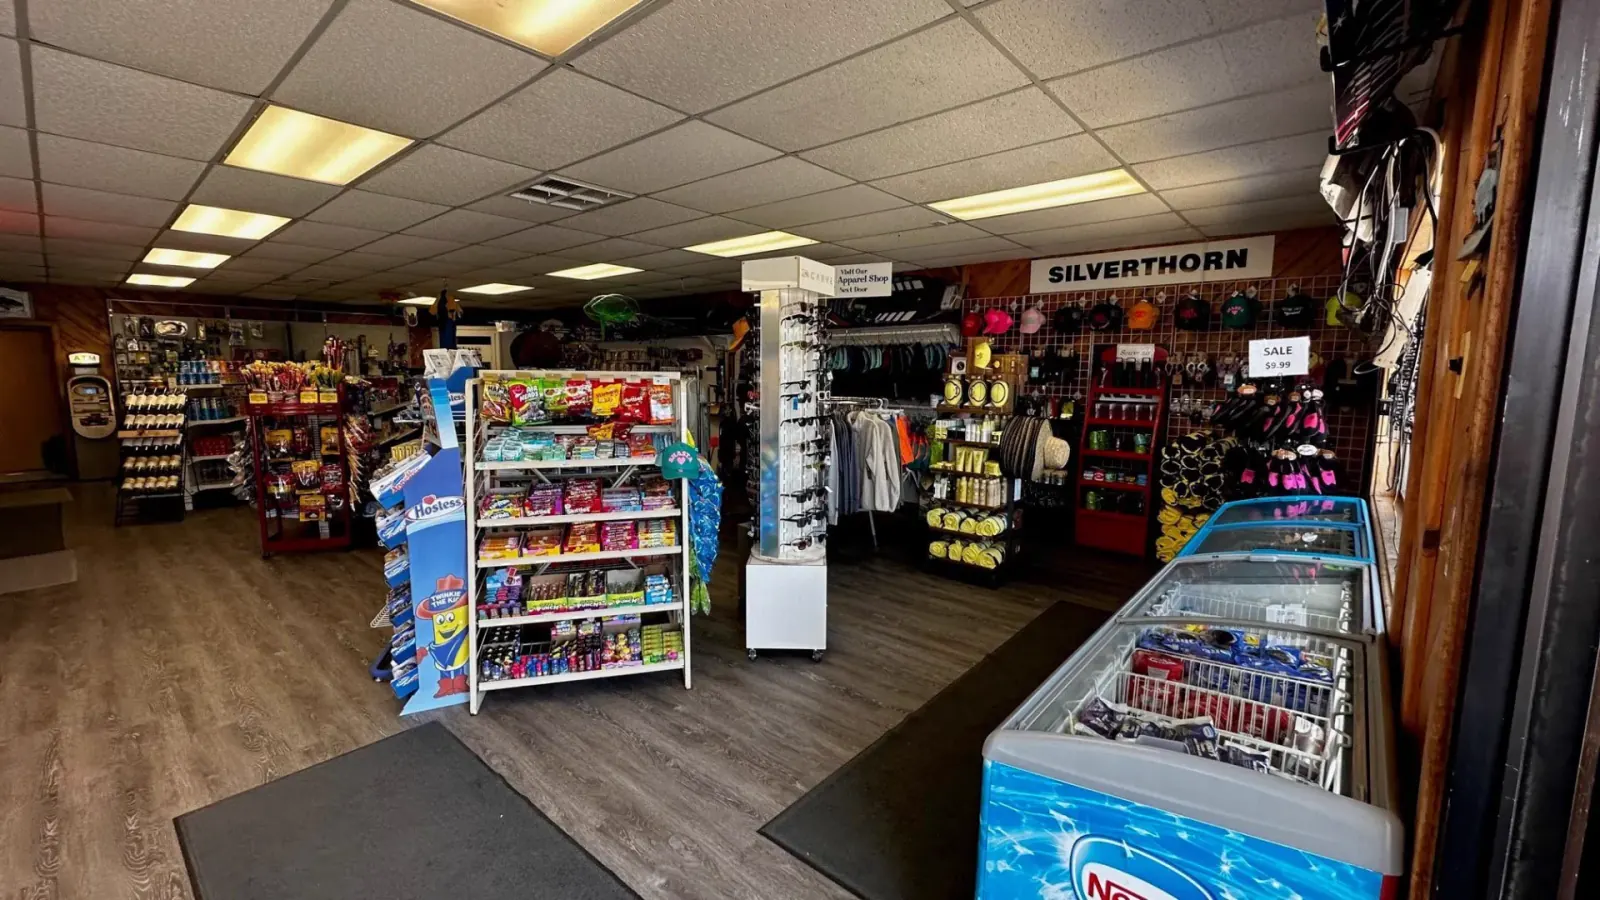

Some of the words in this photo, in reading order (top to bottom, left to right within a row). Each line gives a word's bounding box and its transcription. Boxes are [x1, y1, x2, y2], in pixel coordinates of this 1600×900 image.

[1048, 248, 1249, 284] SILVERTHORN
[838, 275, 867, 286] Apparel
[868, 274, 889, 284] Shop
[1263, 346, 1293, 357] SALE
[1265, 361, 1291, 370] $9.99
[414, 498, 462, 519] Hostess
[430, 591, 462, 602] TWINKIE
[431, 600, 447, 608] THE
